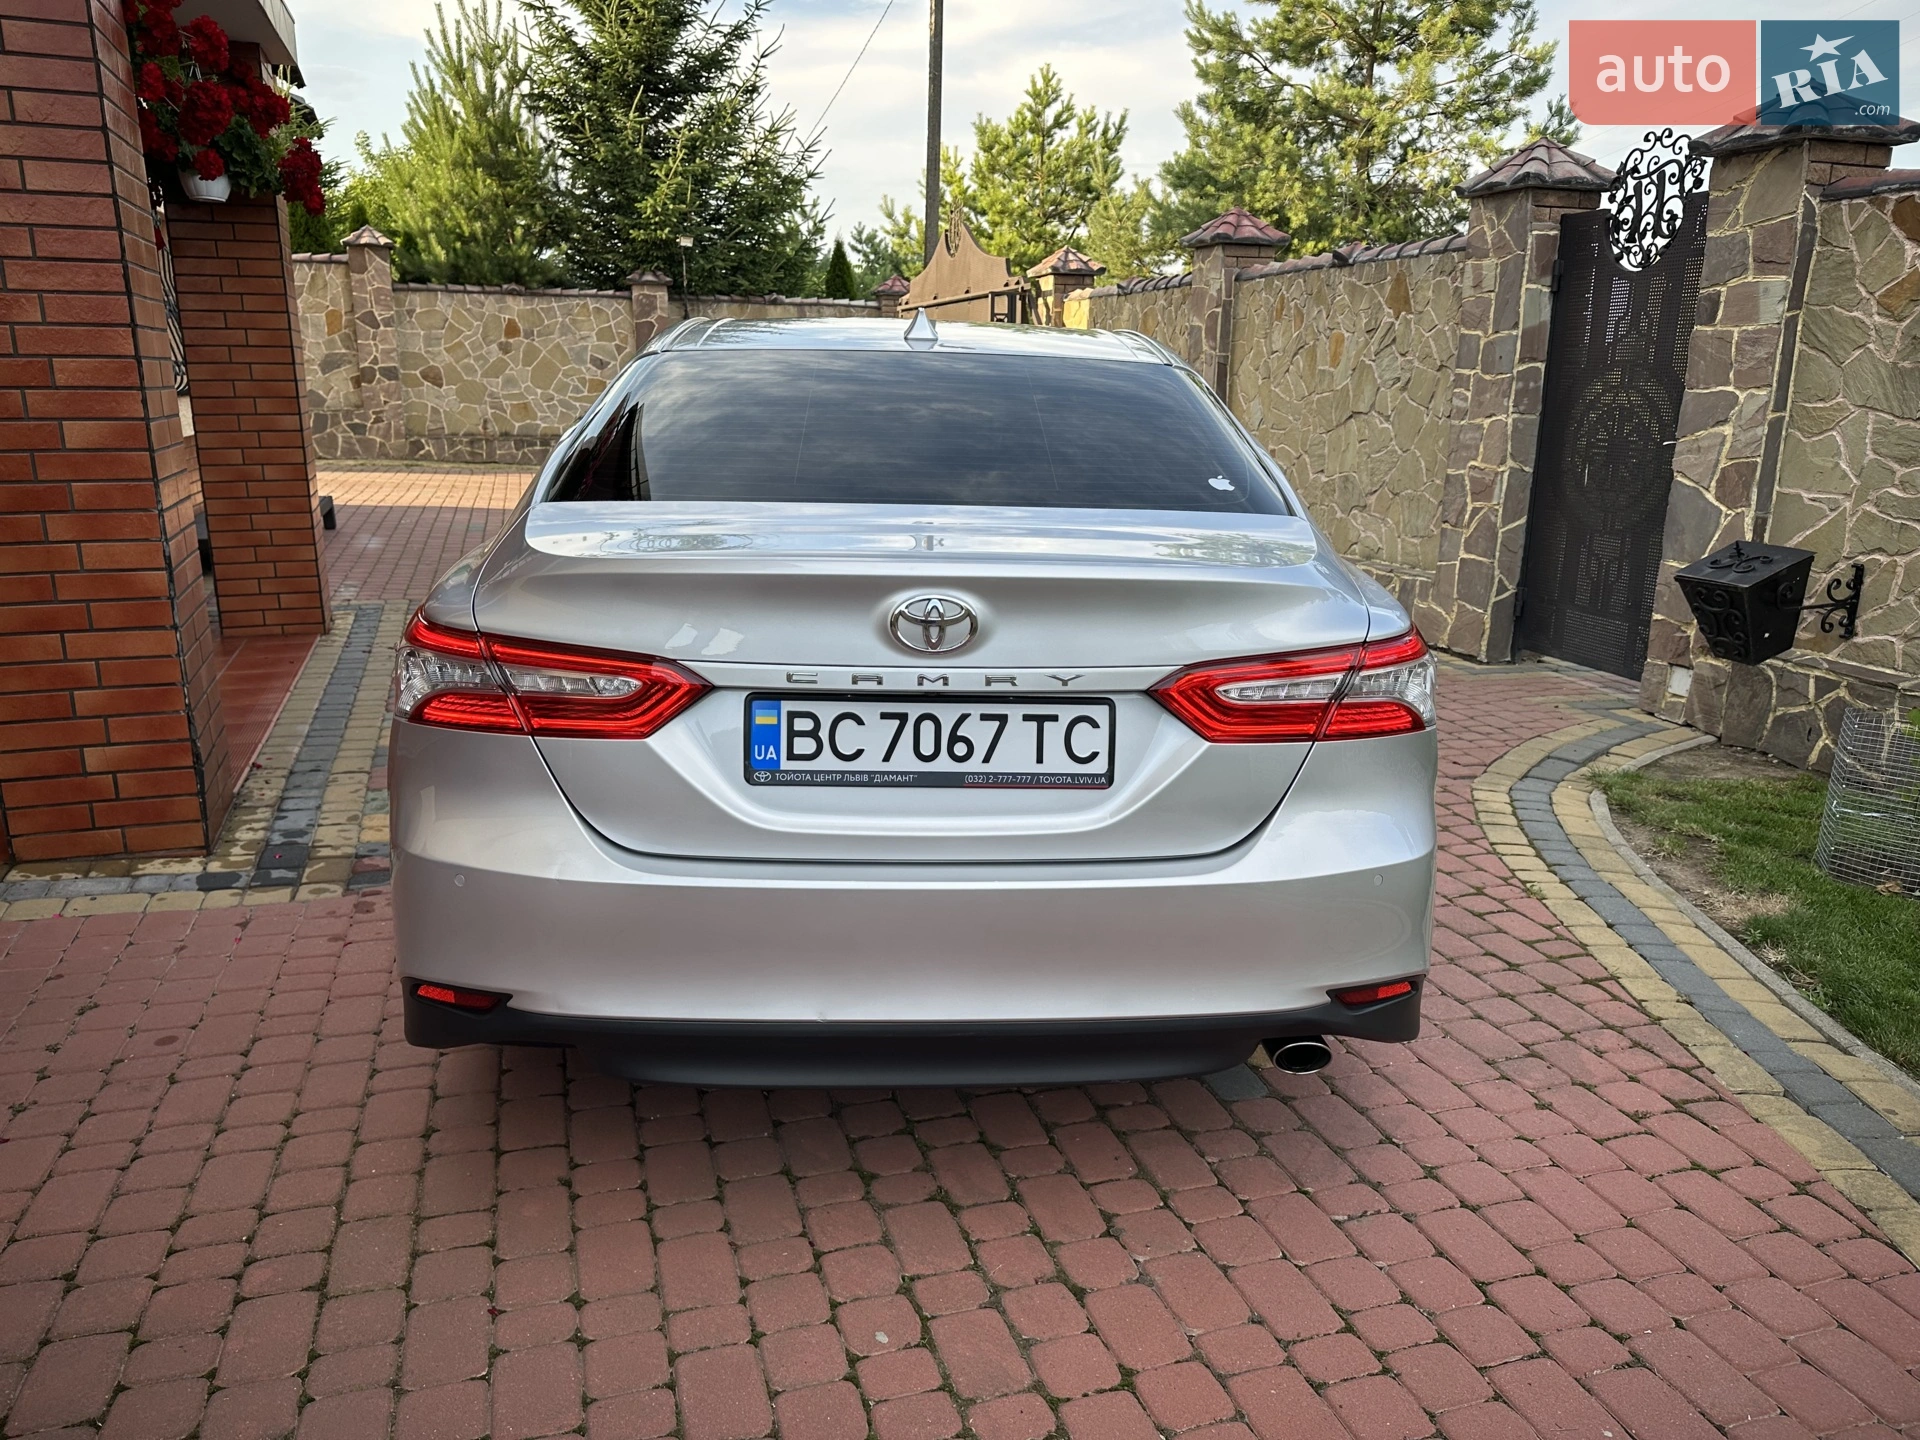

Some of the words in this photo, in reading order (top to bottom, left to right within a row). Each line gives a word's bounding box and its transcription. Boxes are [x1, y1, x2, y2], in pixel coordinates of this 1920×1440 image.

[785, 671, 1086, 687] CAMRY
[786, 710, 866, 762] BC
[879, 711, 1009, 764] 7067
[1022, 713, 1101, 765] TC
[754, 744, 777, 761] UA
[775, 771, 812, 782] ТОЙОТА
[813, 773, 842, 783] ЦЕНТР
[843, 773, 869, 782] ЛЬВІВ
[964, 774, 987, 785] (032)
[989, 775, 1032, 784] 2-777-777
[1039, 775, 1107, 785] TOYOTA.LVIV.UA
